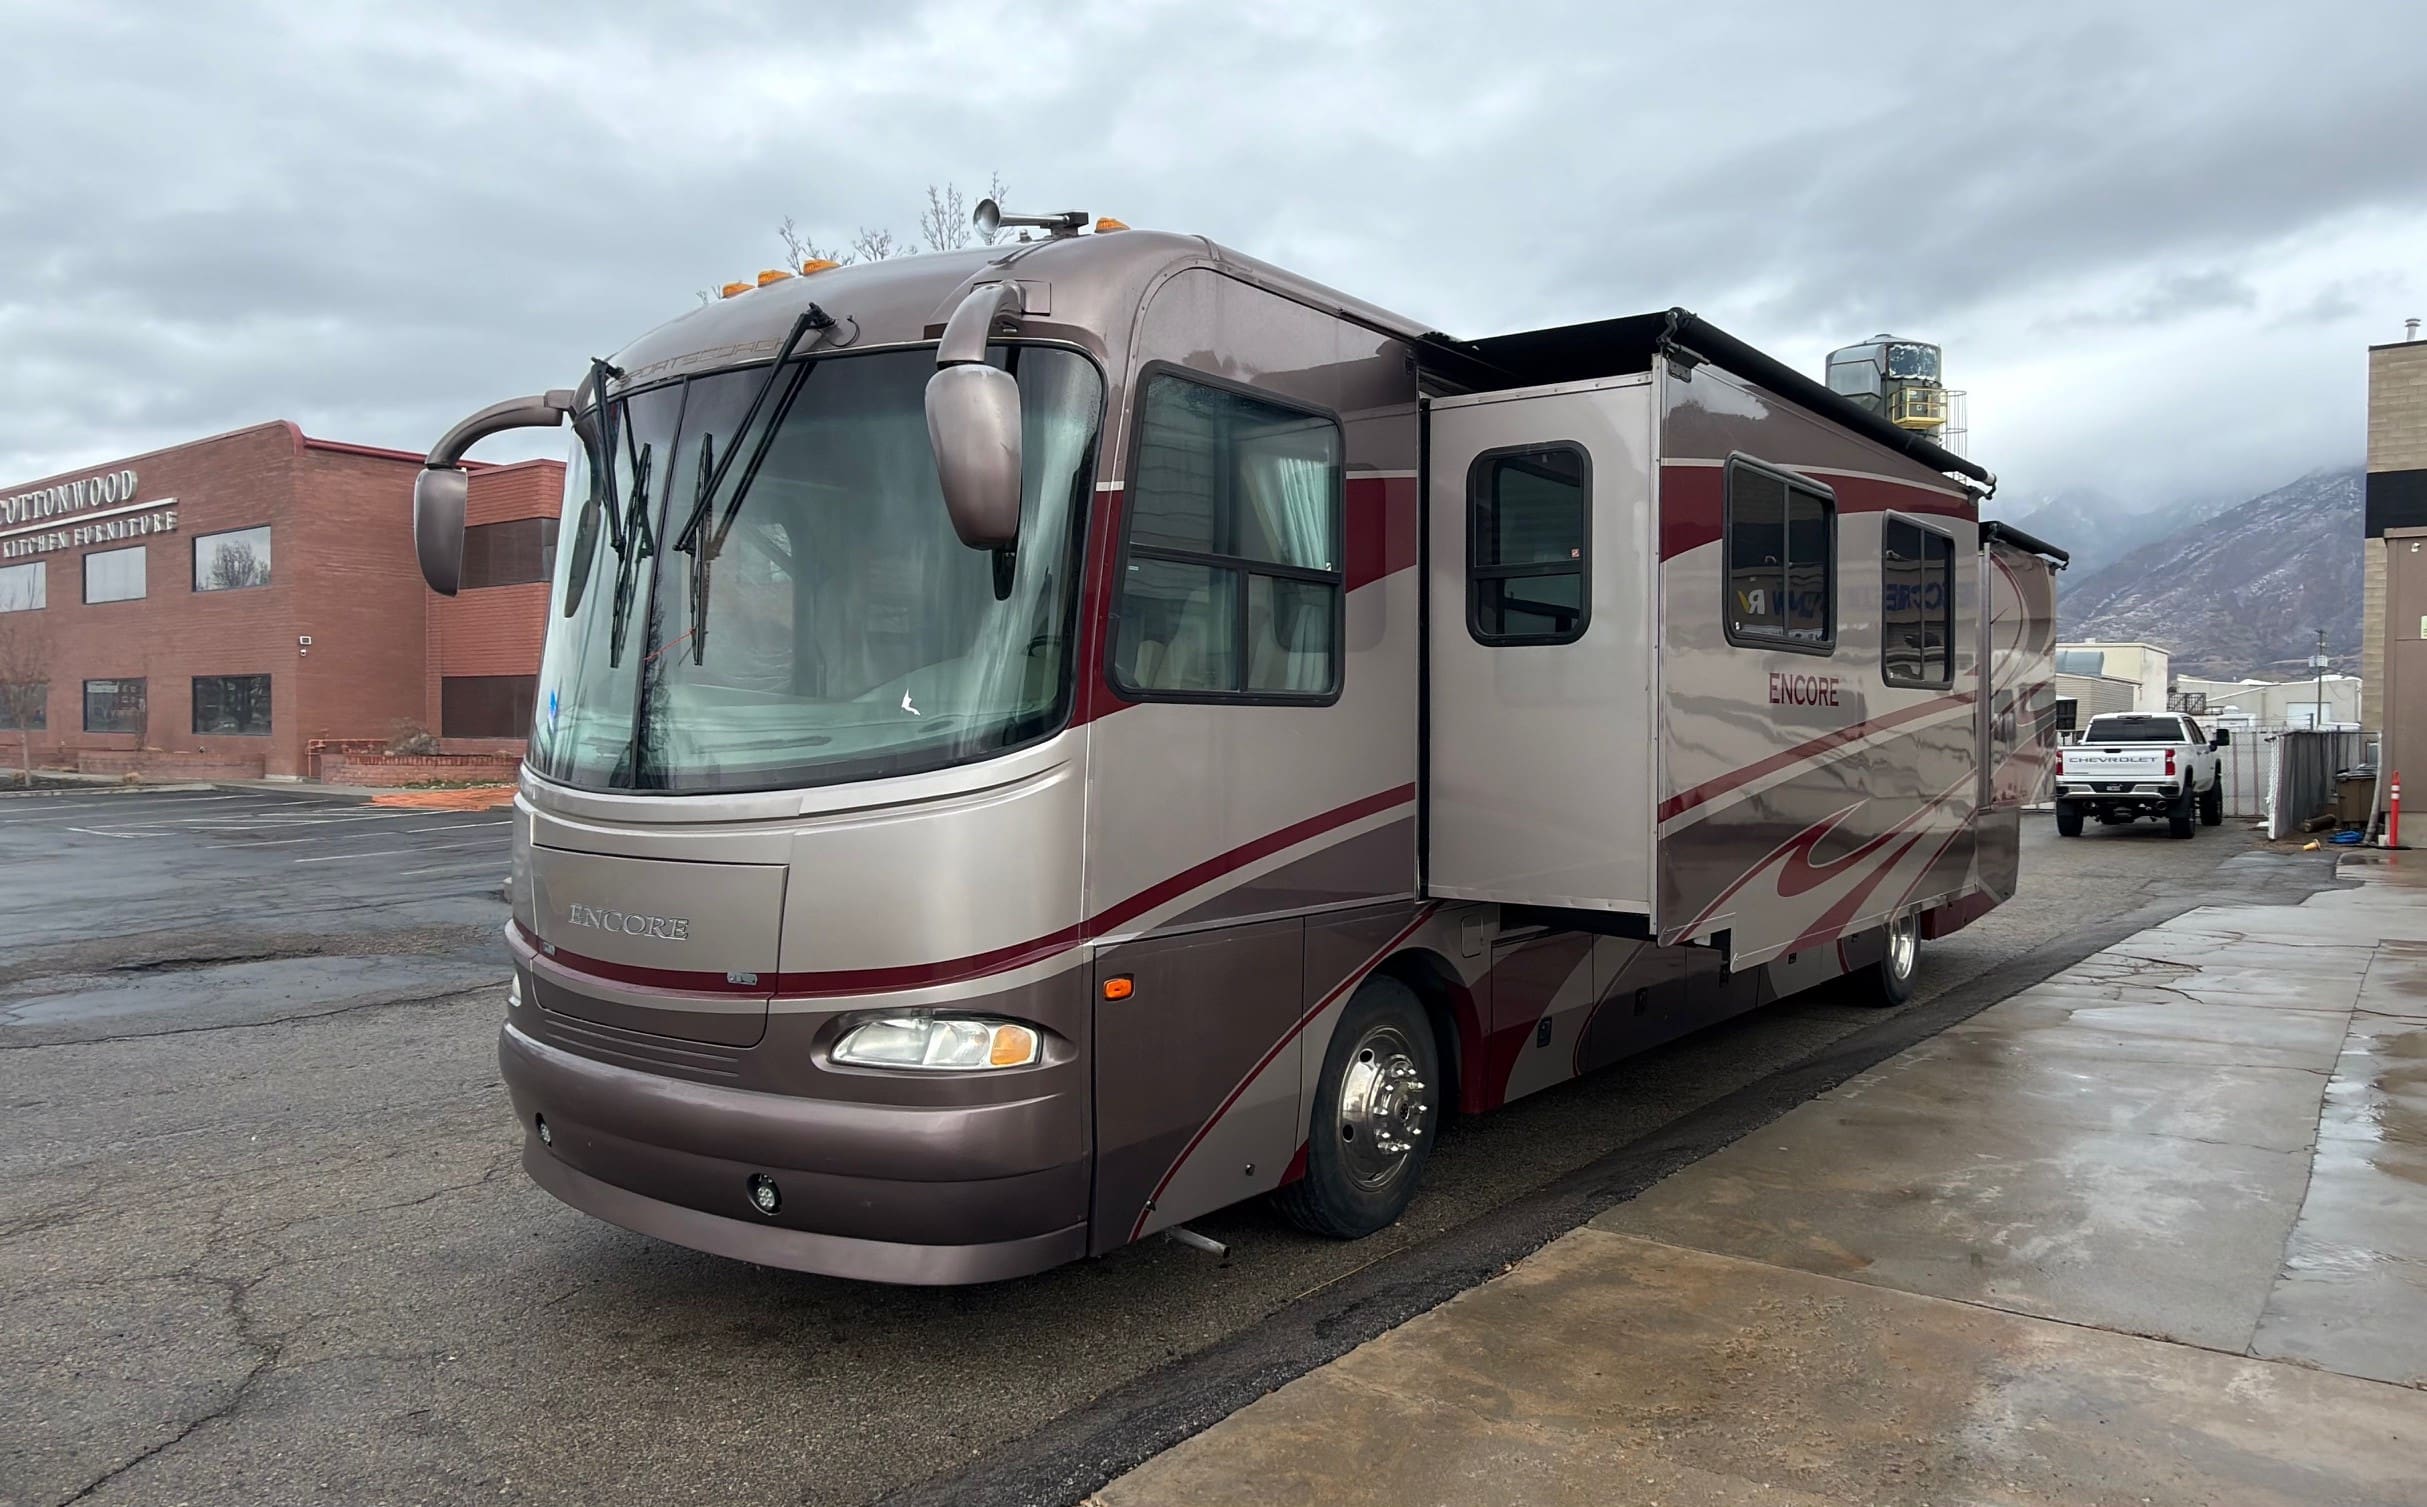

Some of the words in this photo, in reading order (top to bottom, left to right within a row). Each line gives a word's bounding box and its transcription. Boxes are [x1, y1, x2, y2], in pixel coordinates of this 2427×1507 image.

[0, 470, 136, 525] OTTONWOOD
[3, 531, 70, 558] KITCHEN
[73, 511, 178, 546] FURNITURE
[1769, 672, 1840, 707] ENCORE
[568, 903, 689, 941] ENCORE
